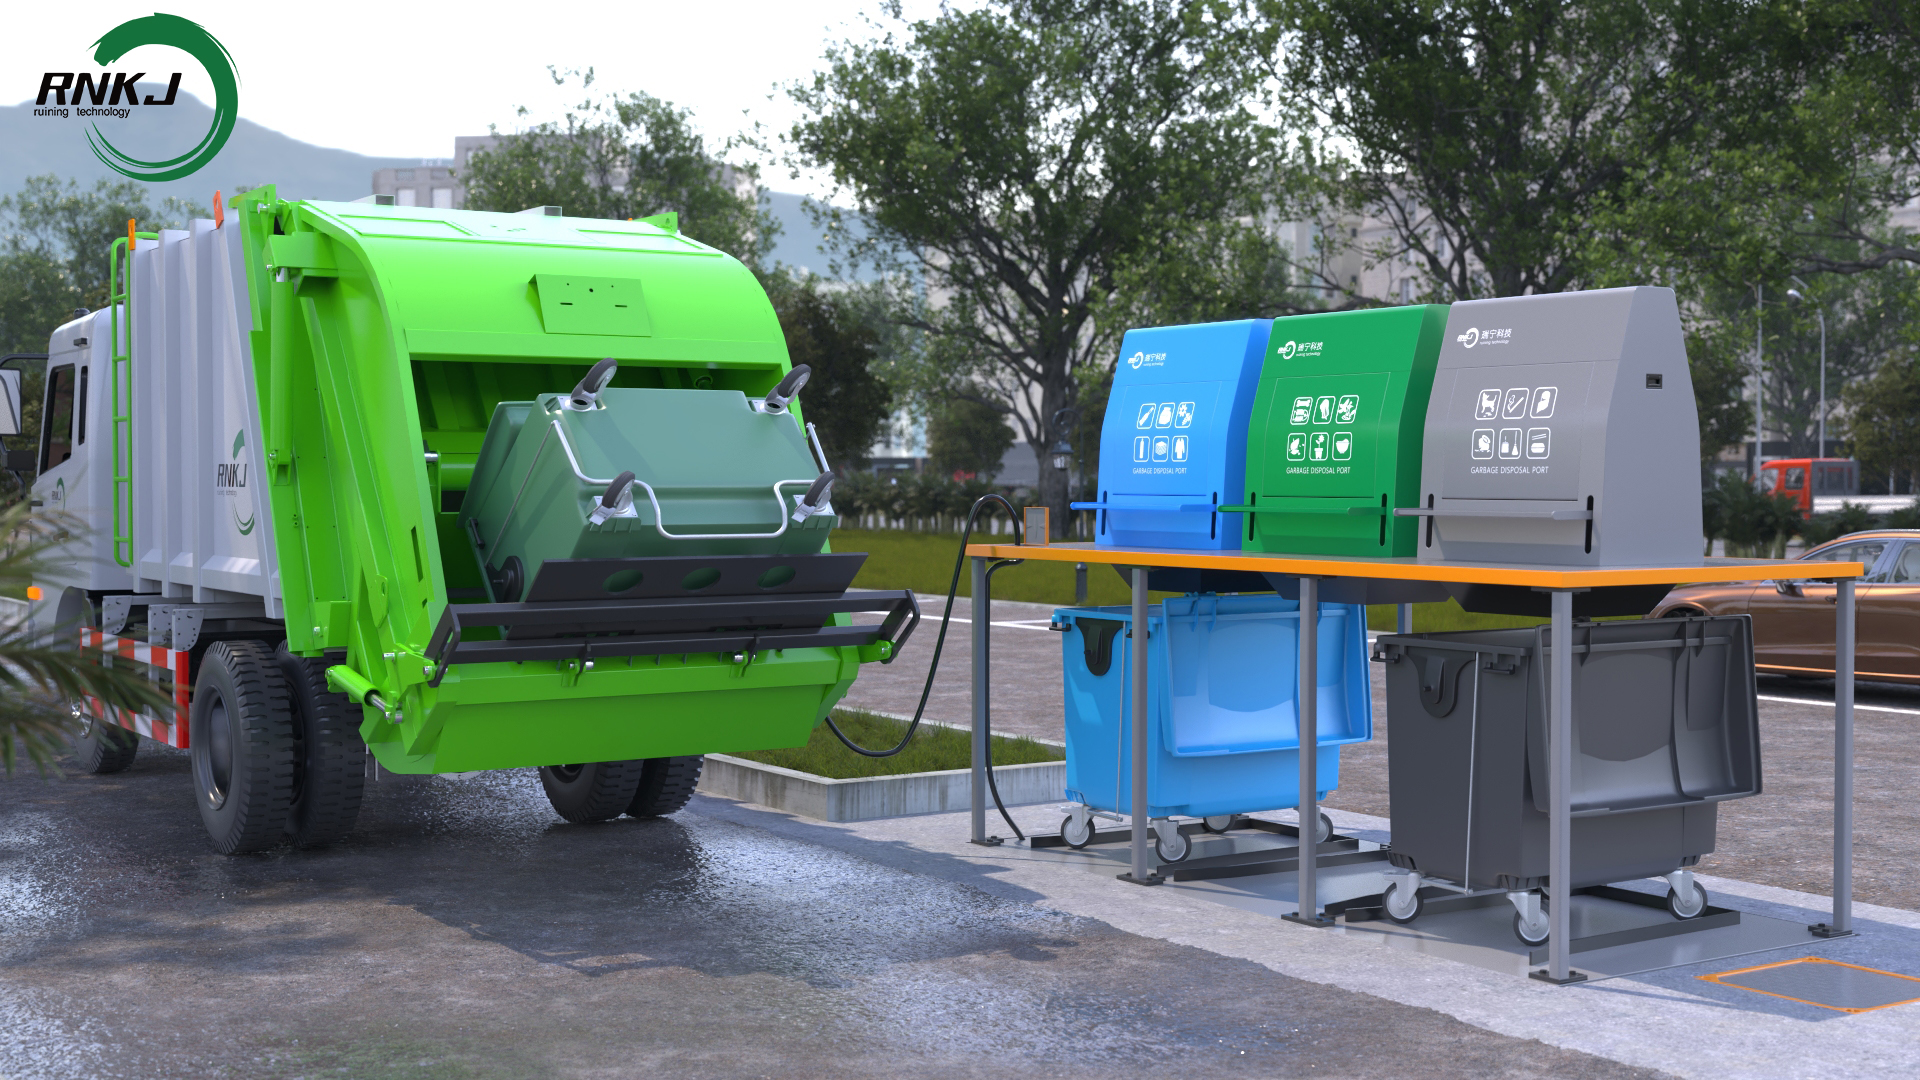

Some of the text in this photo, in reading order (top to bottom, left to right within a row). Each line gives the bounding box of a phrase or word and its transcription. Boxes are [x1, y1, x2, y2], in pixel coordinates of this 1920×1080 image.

[1286, 466, 1351, 474] GARBAGE DISPOSAL PORT
[1470, 466, 1549, 474] GARBAGE DISPOSAL PORT
[217, 463, 247, 487] RNKJ
